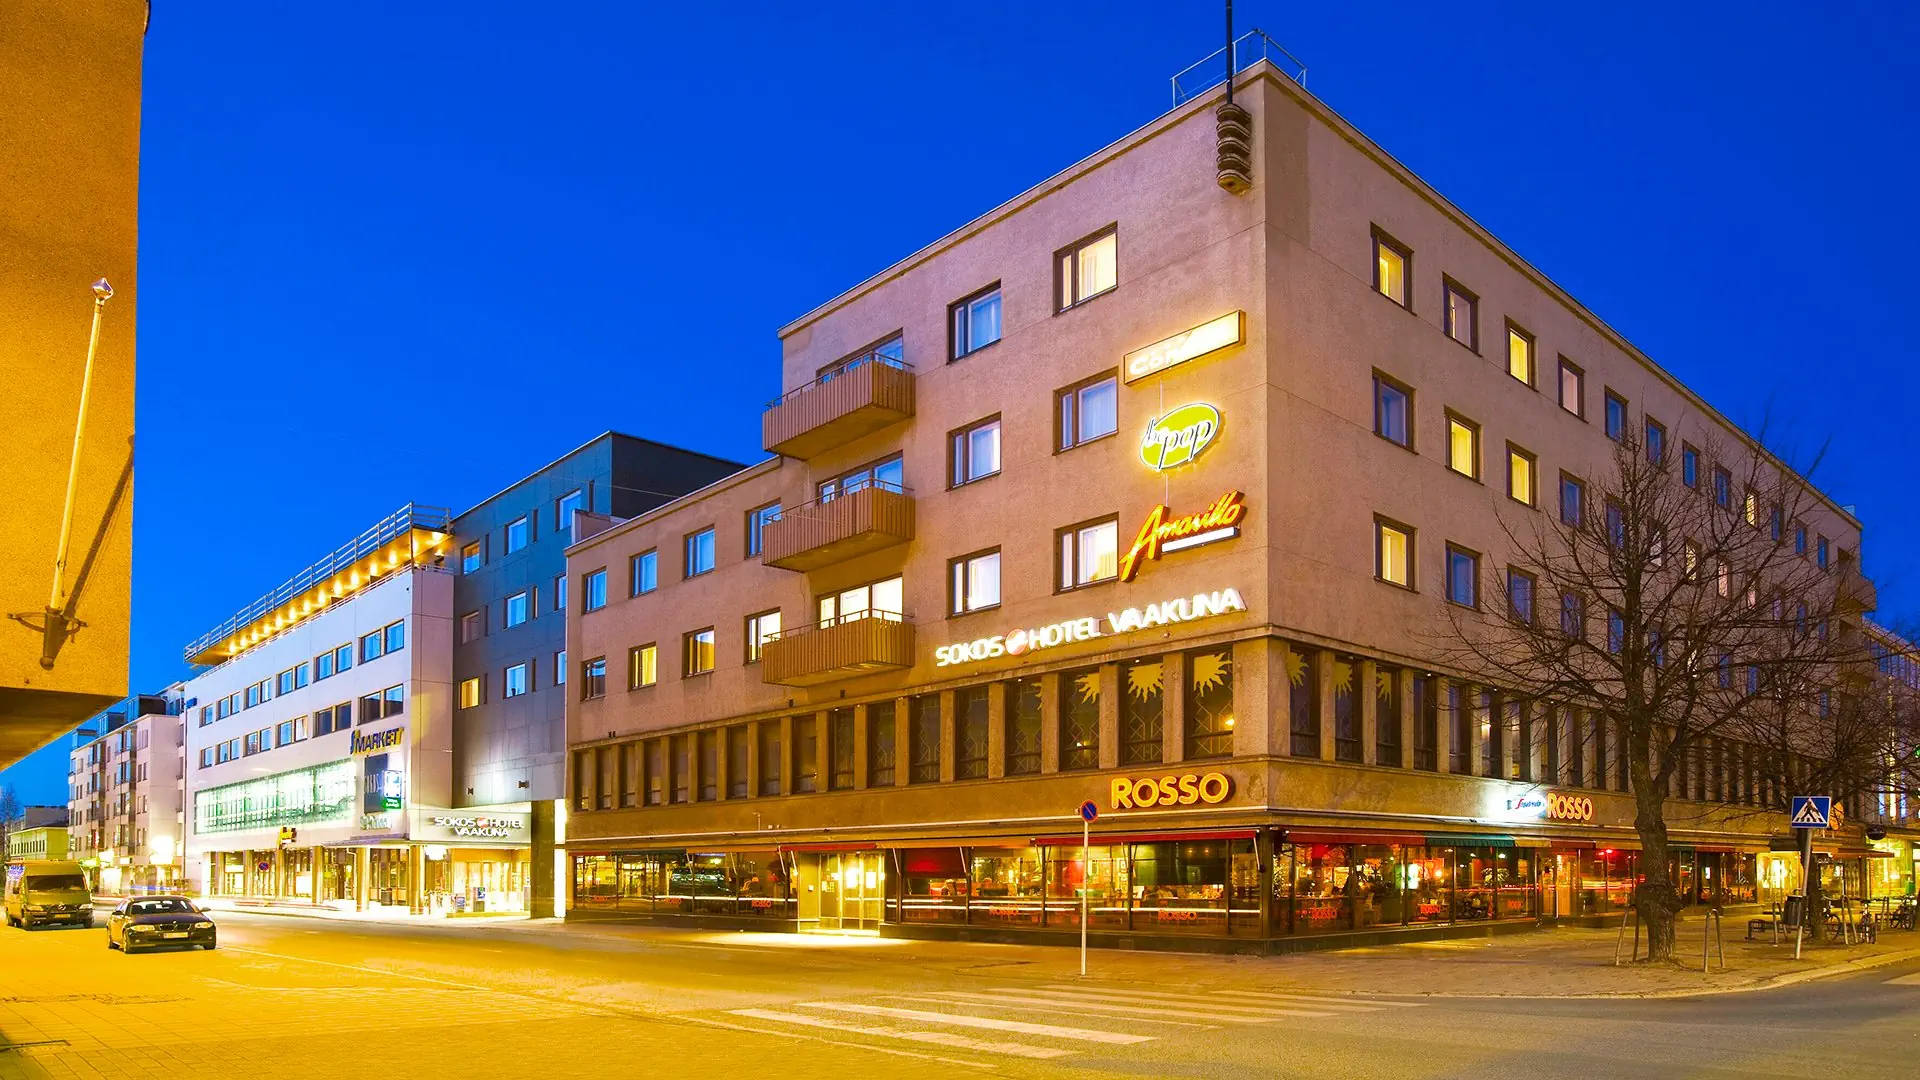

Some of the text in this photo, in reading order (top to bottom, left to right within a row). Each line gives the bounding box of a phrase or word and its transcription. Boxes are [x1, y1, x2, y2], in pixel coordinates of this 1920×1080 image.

[1119, 490, 1242, 582] Amarillo
[935, 588, 1246, 667] SOKOS HOTEL VAAKUNA
[1111, 772, 1229, 809] ROSSO
[1546, 792, 1593, 821] ROSSO
[433, 816, 524, 829] SOKOS HOTEL
[455, 827, 510, 837] VAAKUNA
[1158, 909, 1197, 921] ROSSO
